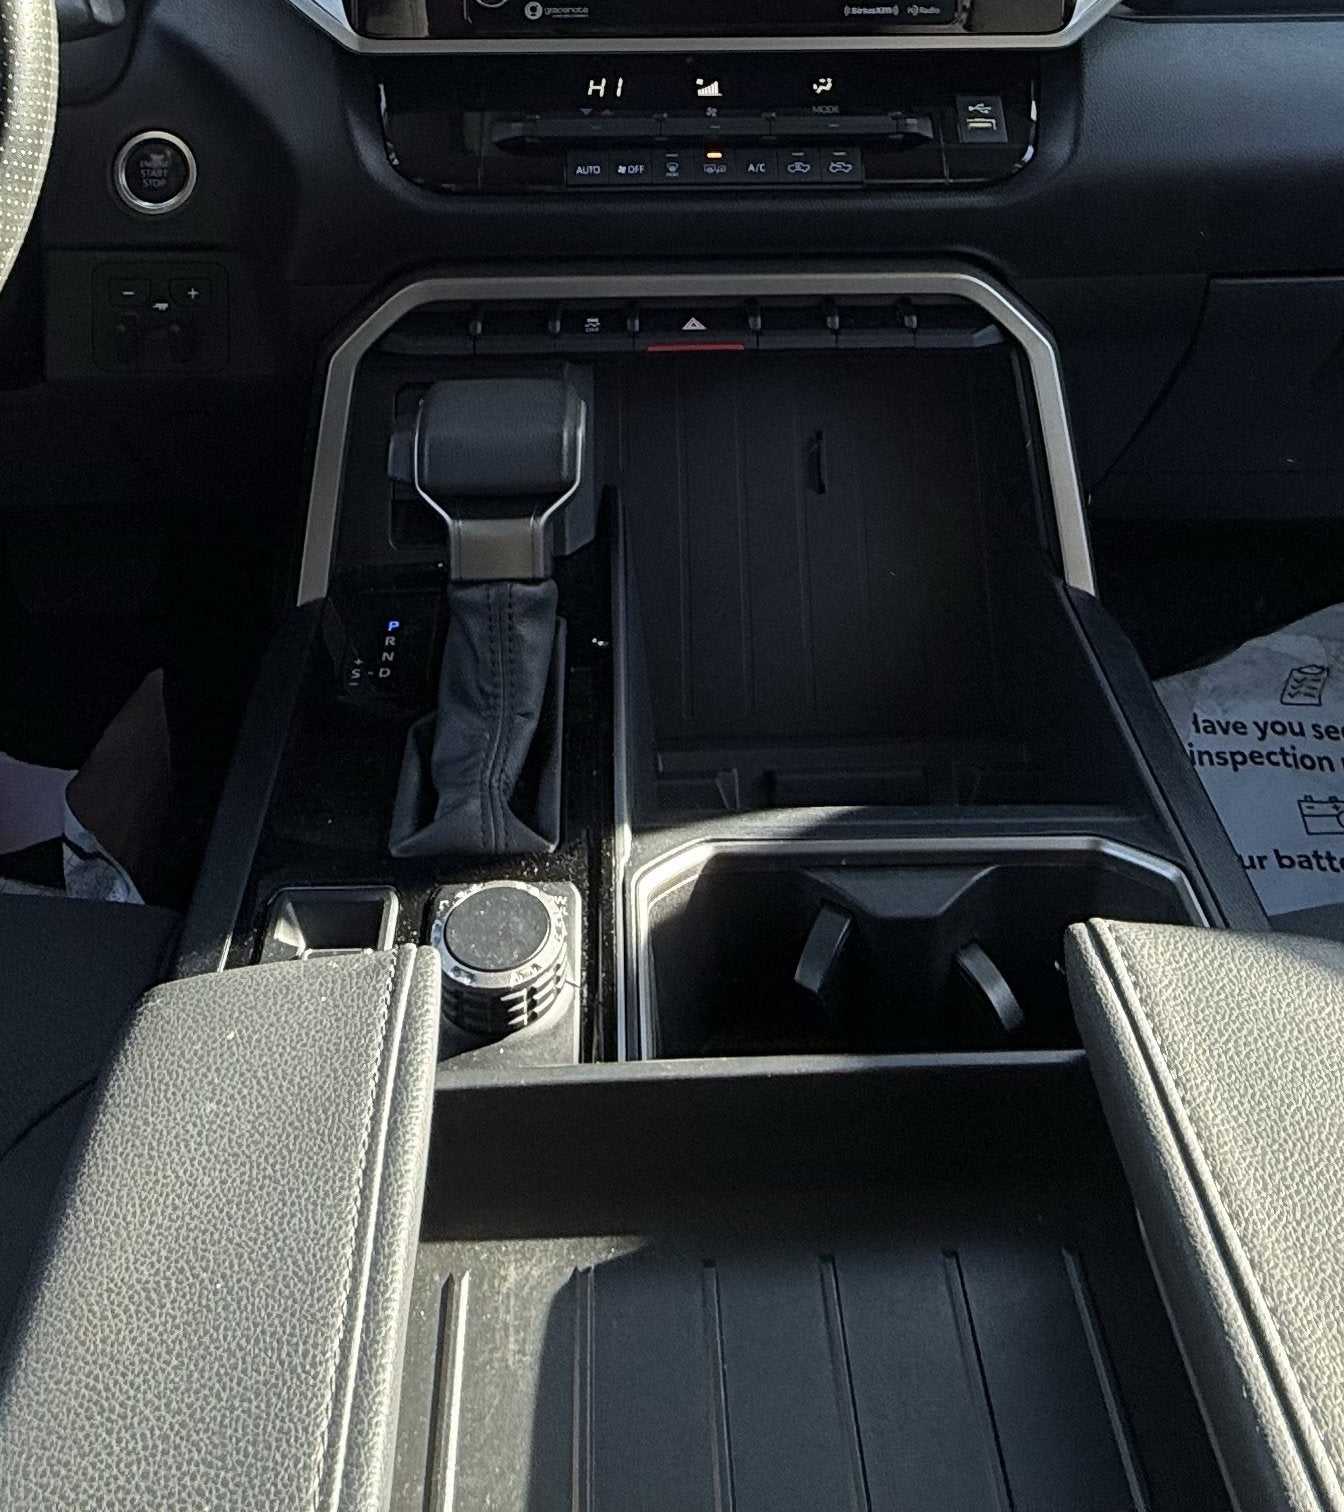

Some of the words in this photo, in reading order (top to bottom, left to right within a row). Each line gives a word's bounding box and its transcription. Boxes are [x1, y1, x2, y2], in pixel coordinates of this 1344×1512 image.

[140, 168, 168, 178] START
[576, 165, 601, 175] AUTO
[627, 164, 645, 174] OFF
[747, 163, 766, 173] A/C
[143, 178, 166, 188] STOP
[387, 620, 400, 632] P
[385, 635, 396, 646] R
[381, 651, 395, 662] N
[351, 668, 361, 679] S
[378, 668, 391, 678] D
[1253, 718, 1306, 742] you
[1187, 742, 1336, 772] inspection
[1237, 853, 1268, 870] ur
